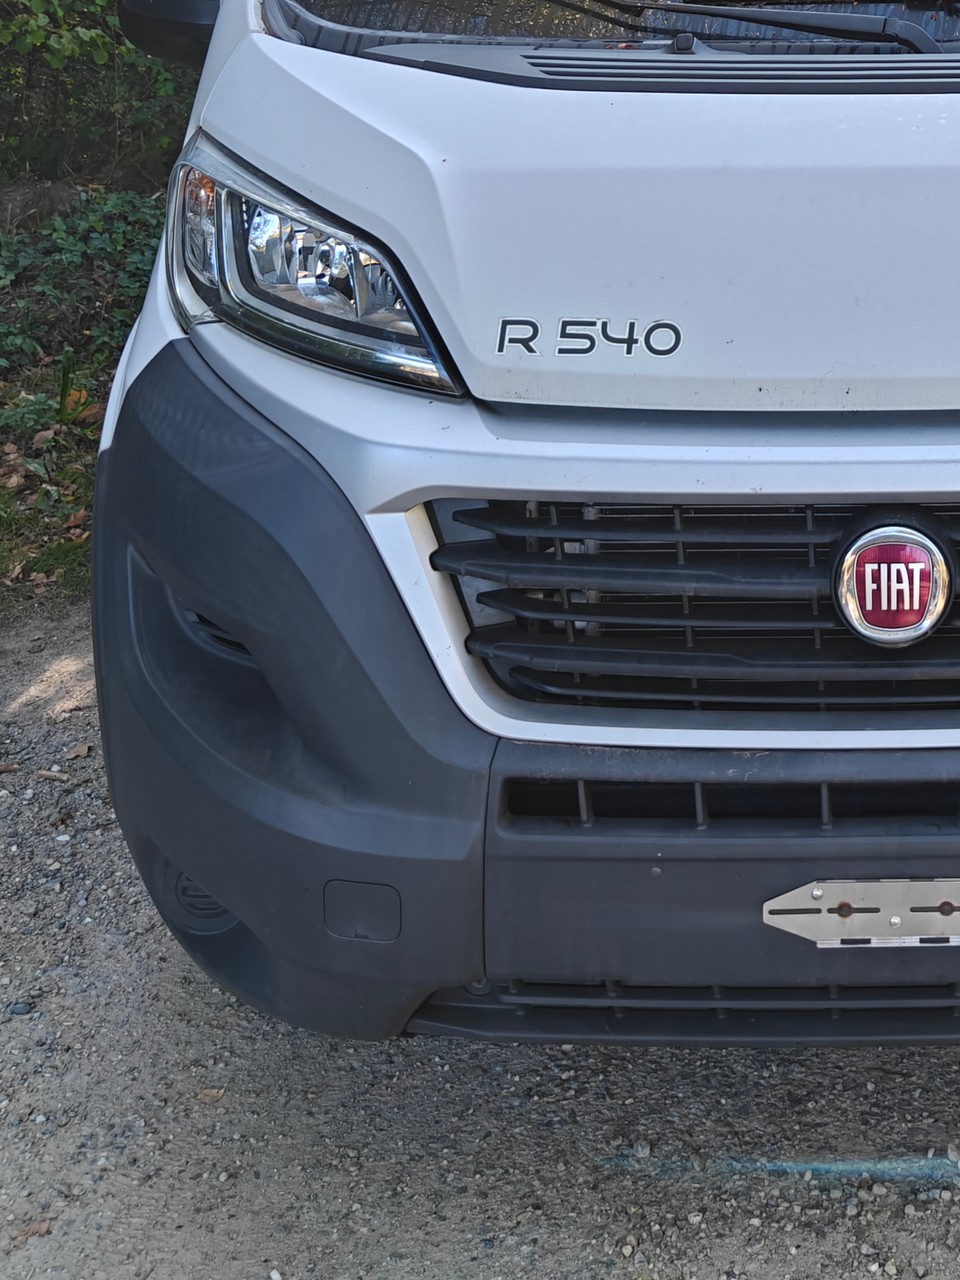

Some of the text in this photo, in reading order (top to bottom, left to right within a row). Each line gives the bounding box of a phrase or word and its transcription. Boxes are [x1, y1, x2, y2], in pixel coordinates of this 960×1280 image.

[497, 318, 683, 357] R 540
[864, 562, 926, 611] FIAT
